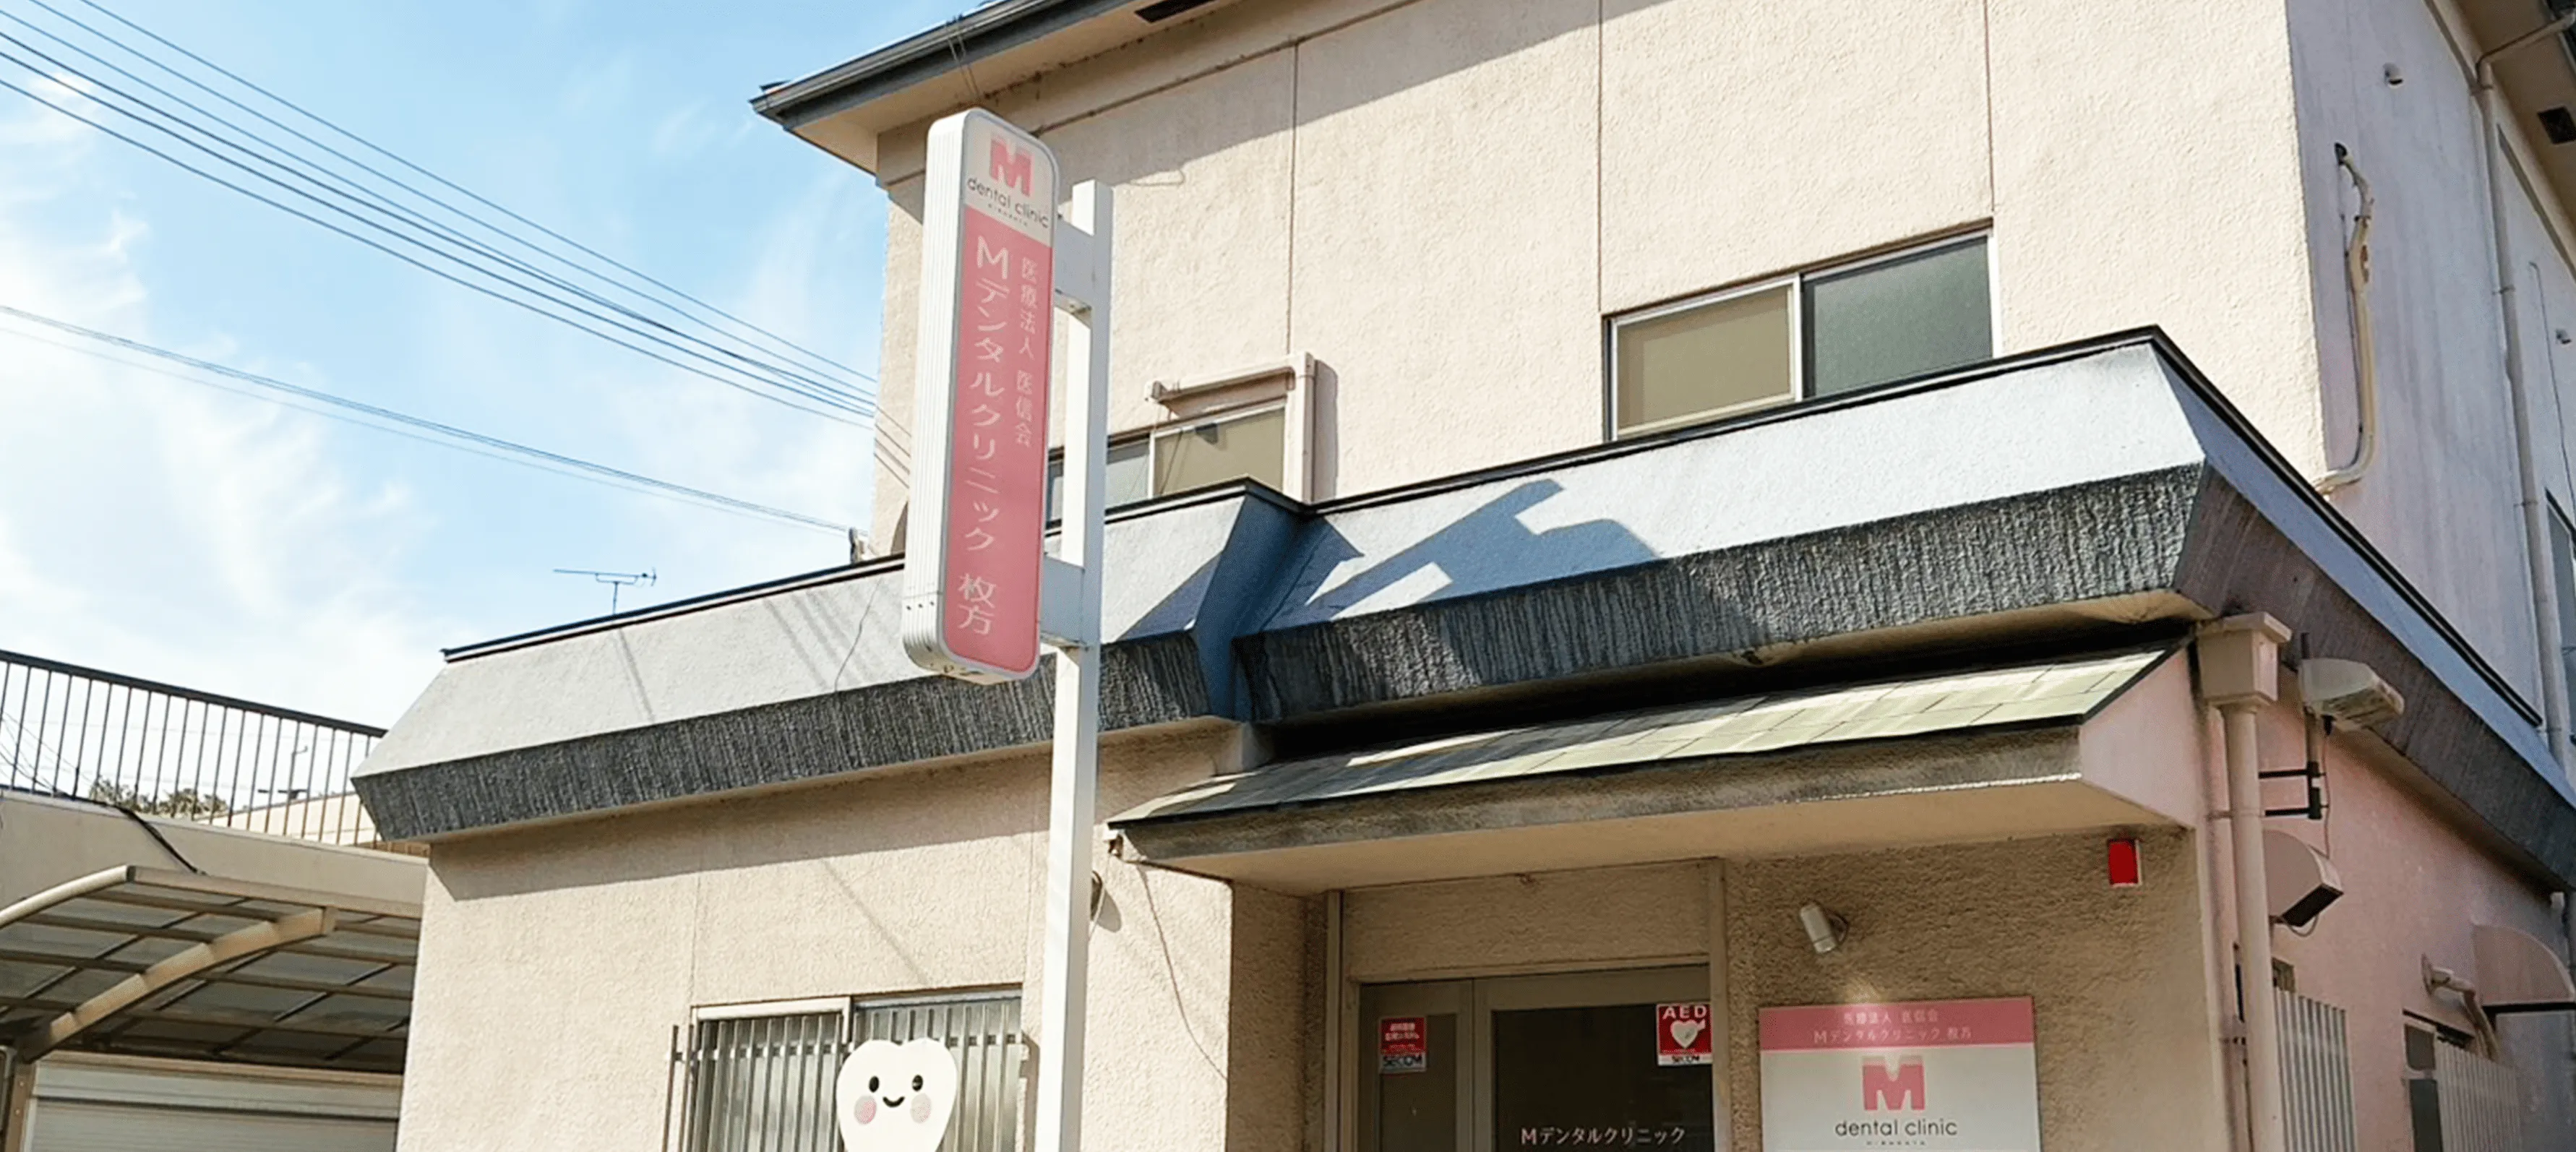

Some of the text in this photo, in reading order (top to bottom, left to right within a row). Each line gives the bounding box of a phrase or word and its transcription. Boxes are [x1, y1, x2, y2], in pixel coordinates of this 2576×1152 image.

[989, 137, 1031, 198] M
[967, 177, 1010, 208] dental
[1014, 202, 1049, 228] clinic
[963, 235, 1010, 551] Mデンタルクリニック
[957, 572, 997, 636] 枚方
[1662, 1005, 1707, 1020] AED
[1862, 1058, 1926, 1112] M
[1521, 1126, 1686, 1146] Mデンタルクリニック
[1834, 1119, 1958, 1136] dental clinic
